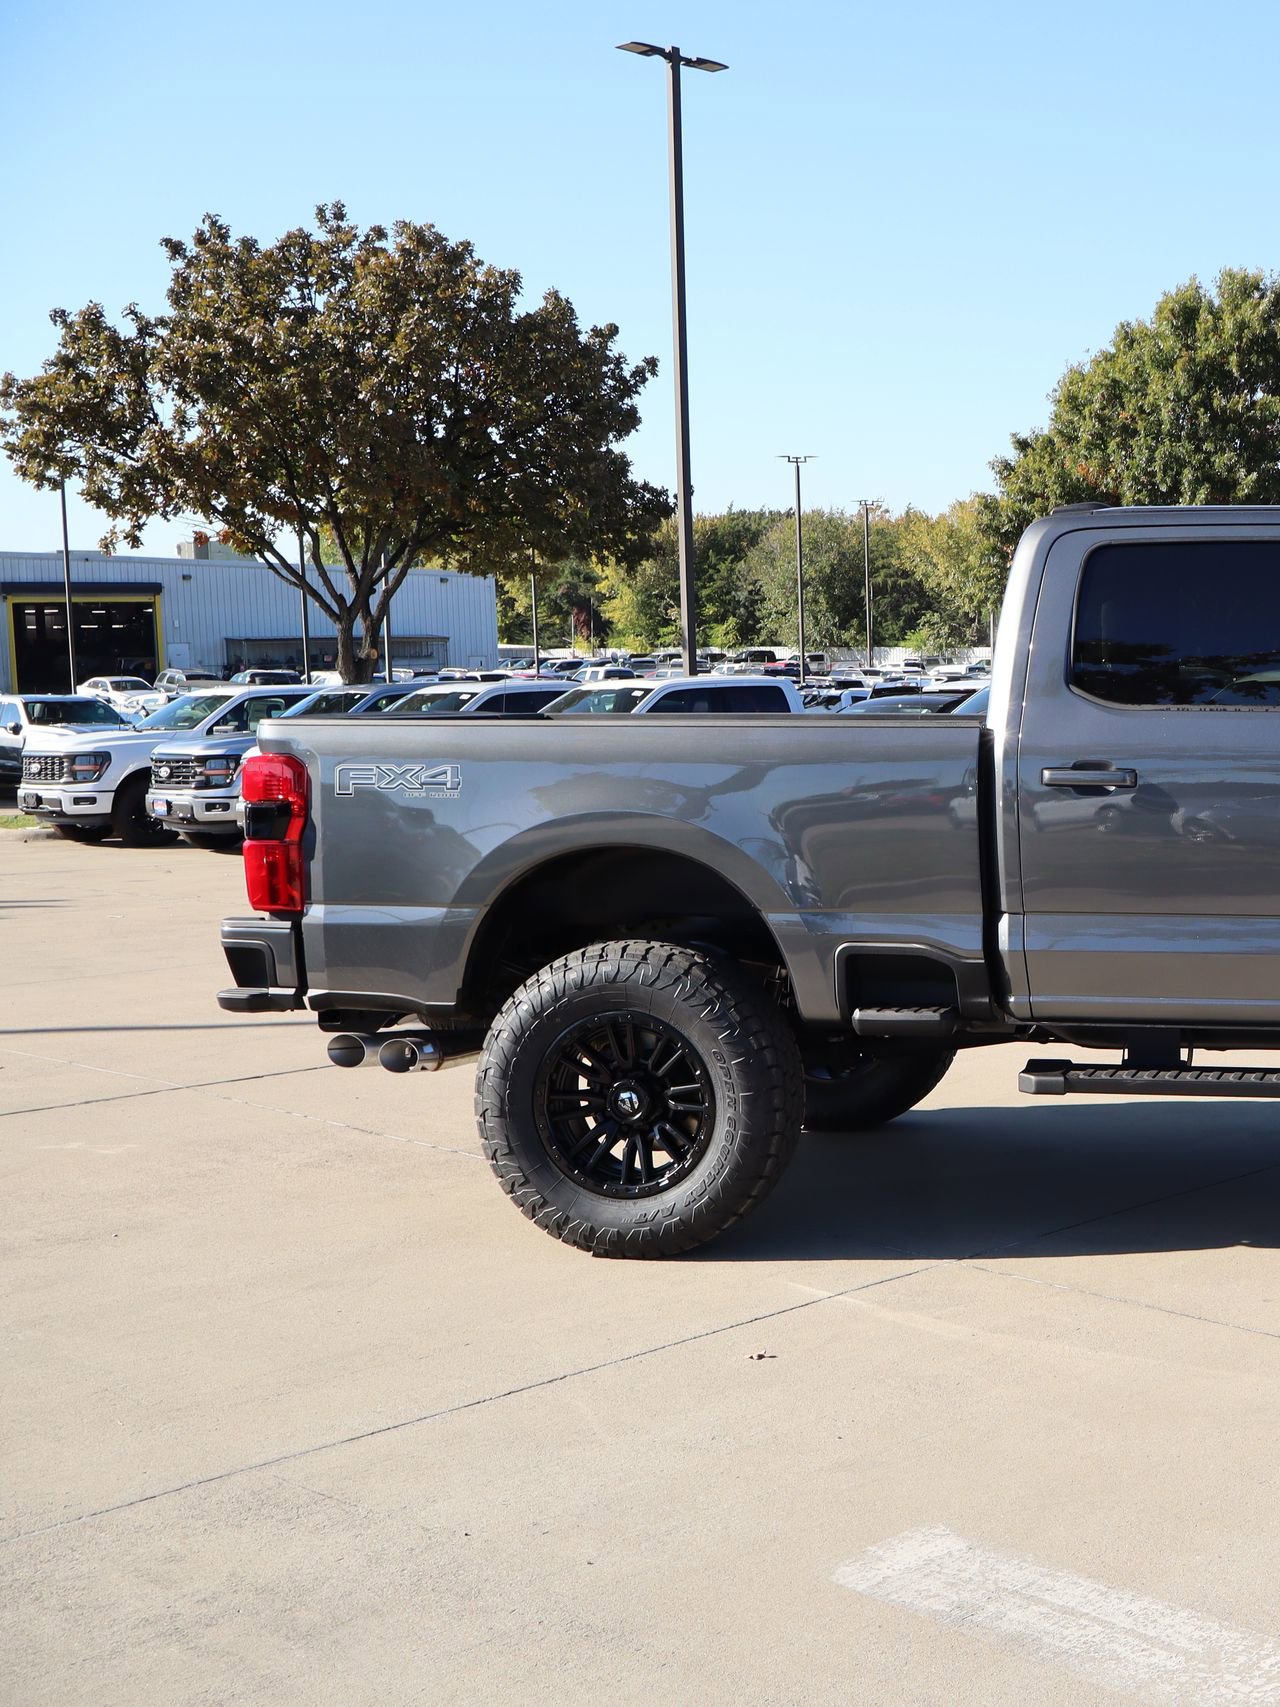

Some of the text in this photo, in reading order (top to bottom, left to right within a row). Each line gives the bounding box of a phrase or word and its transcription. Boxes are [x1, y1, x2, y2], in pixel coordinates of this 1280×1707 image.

[335, 764, 463, 797] FX4
[711, 1049, 737, 1111] OPEN
[684, 1115, 737, 1208] COUNTRY
